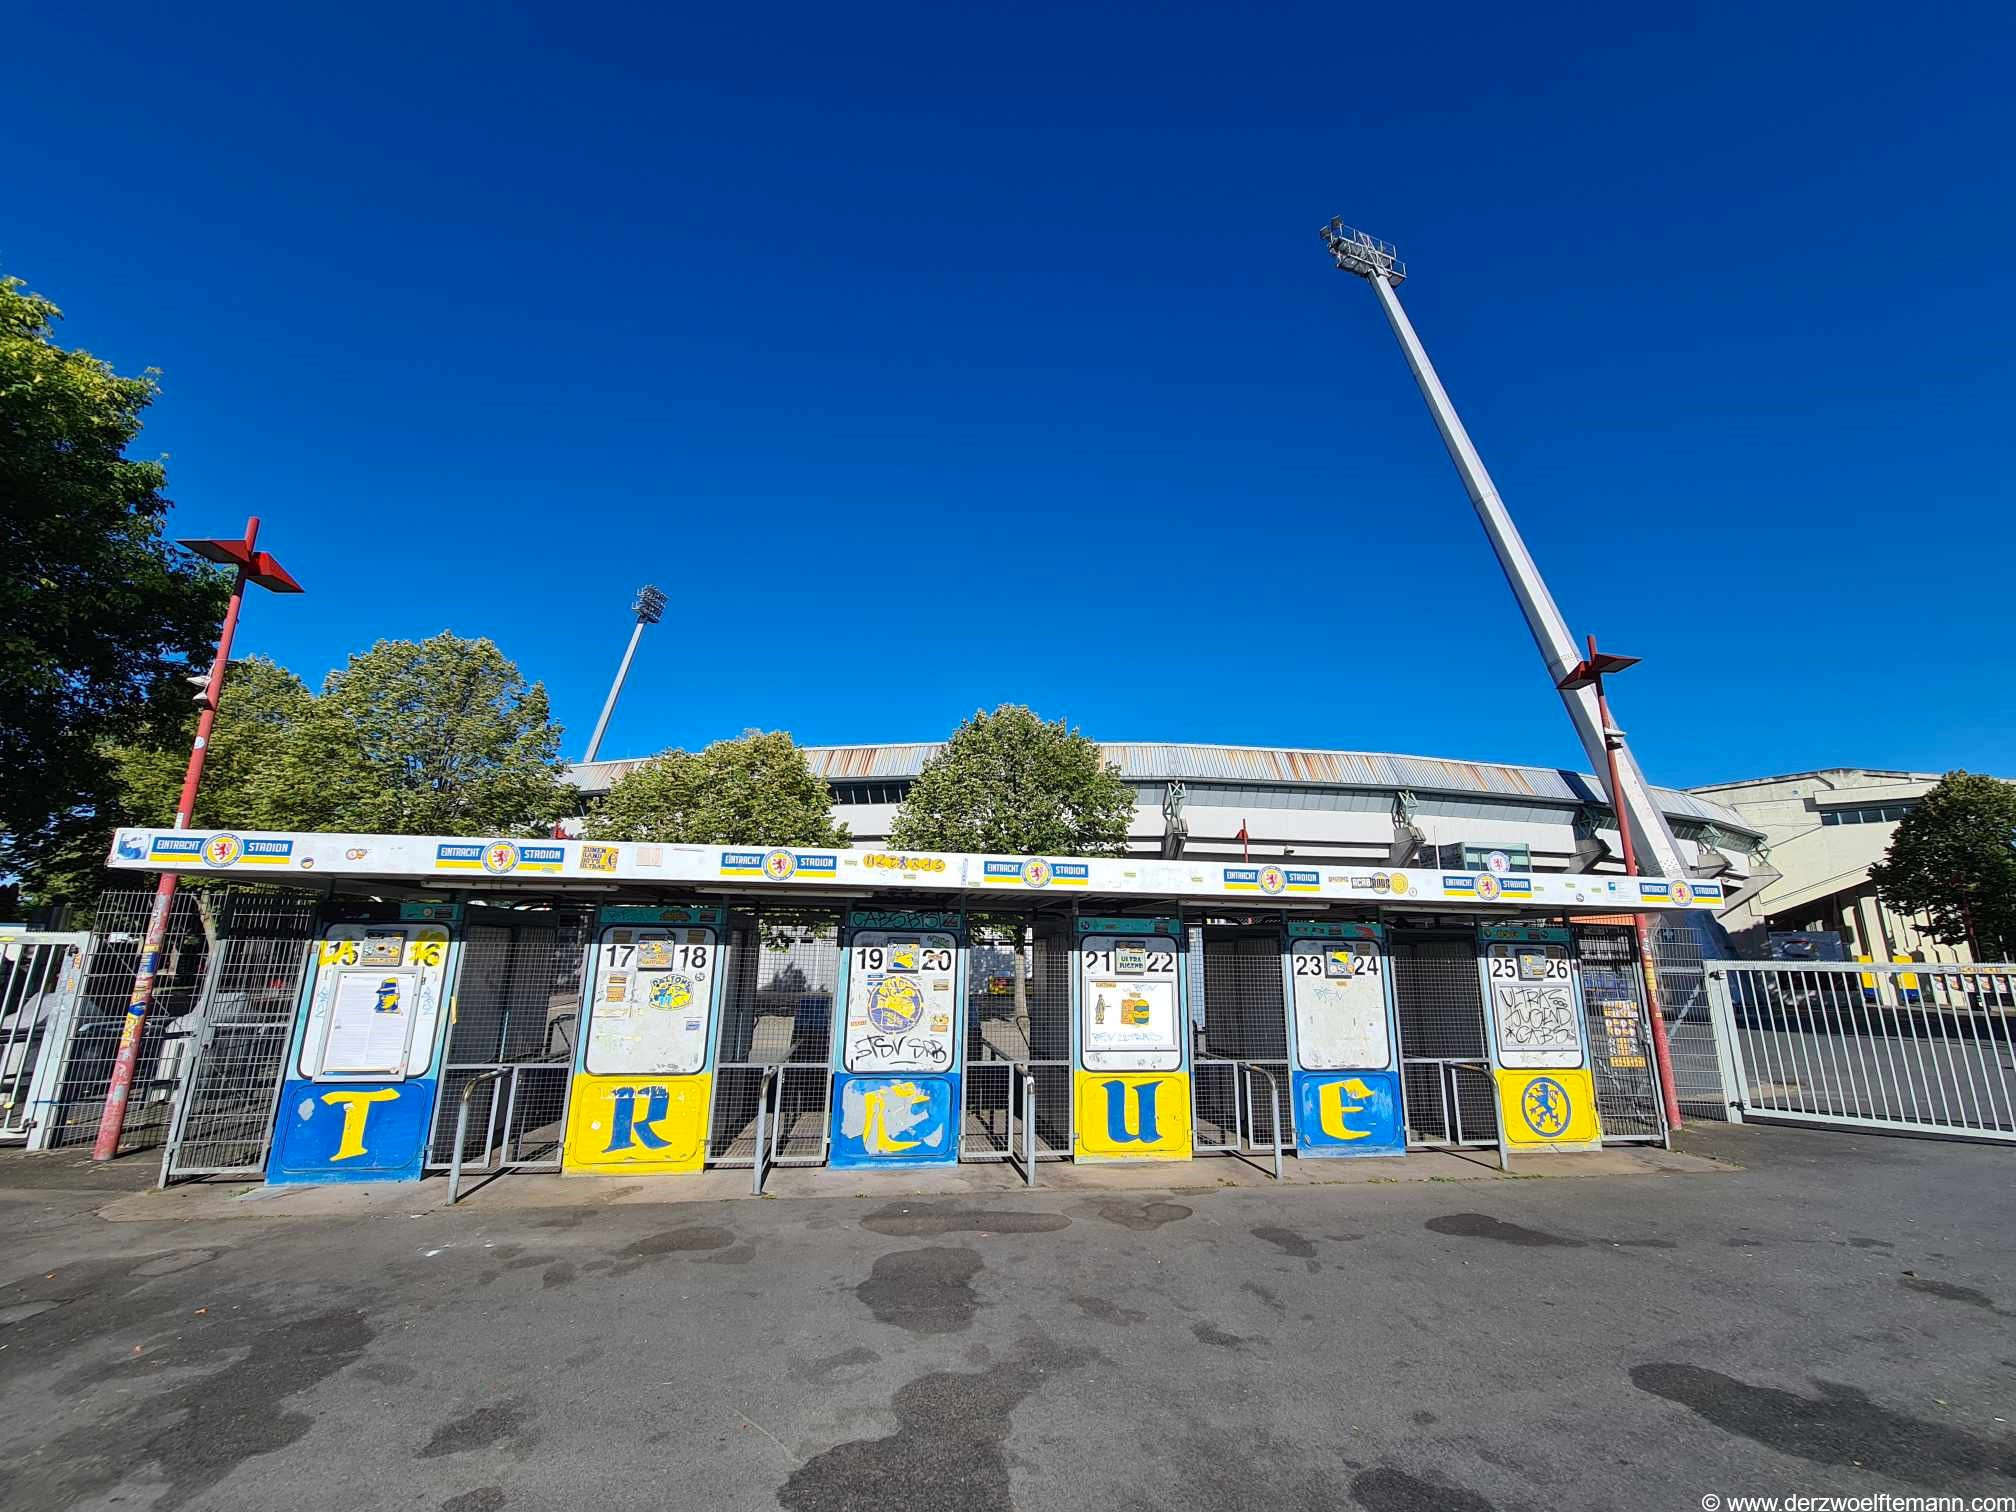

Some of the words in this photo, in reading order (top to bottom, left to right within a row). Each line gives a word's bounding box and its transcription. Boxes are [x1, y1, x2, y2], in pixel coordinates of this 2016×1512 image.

[156, 839, 200, 851] EINTRACHT
[247, 841, 289, 852] STADION
[440, 847, 481, 858] EINTRACHT
[523, 849, 562, 860] STADION
[724, 855, 761, 866] EINTRACHT
[800, 857, 834, 867] STADION
[986, 863, 1020, 873] EINTRACHT
[1055, 865, 1086, 876] STADION
[1226, 871, 1257, 881] EINTRACHT
[1289, 873, 1318, 883] STADION
[606, 945, 636, 968] 17
[680, 946, 707, 969] 18
[857, 948, 884, 970] 19
[921, 949, 952, 971] 20
[1086, 950, 1111, 972] 21
[1146, 951, 1174, 973] 22
[1296, 956, 1322, 976] 23
[1354, 956, 1379, 976] 24
[1492, 959, 1516, 978] 25
[1546, 959, 1568, 978] 26
[1505, 1007, 1572, 1029] JUGEND
[320, 1087, 400, 1162] T
[600, 1086, 672, 1154] R
